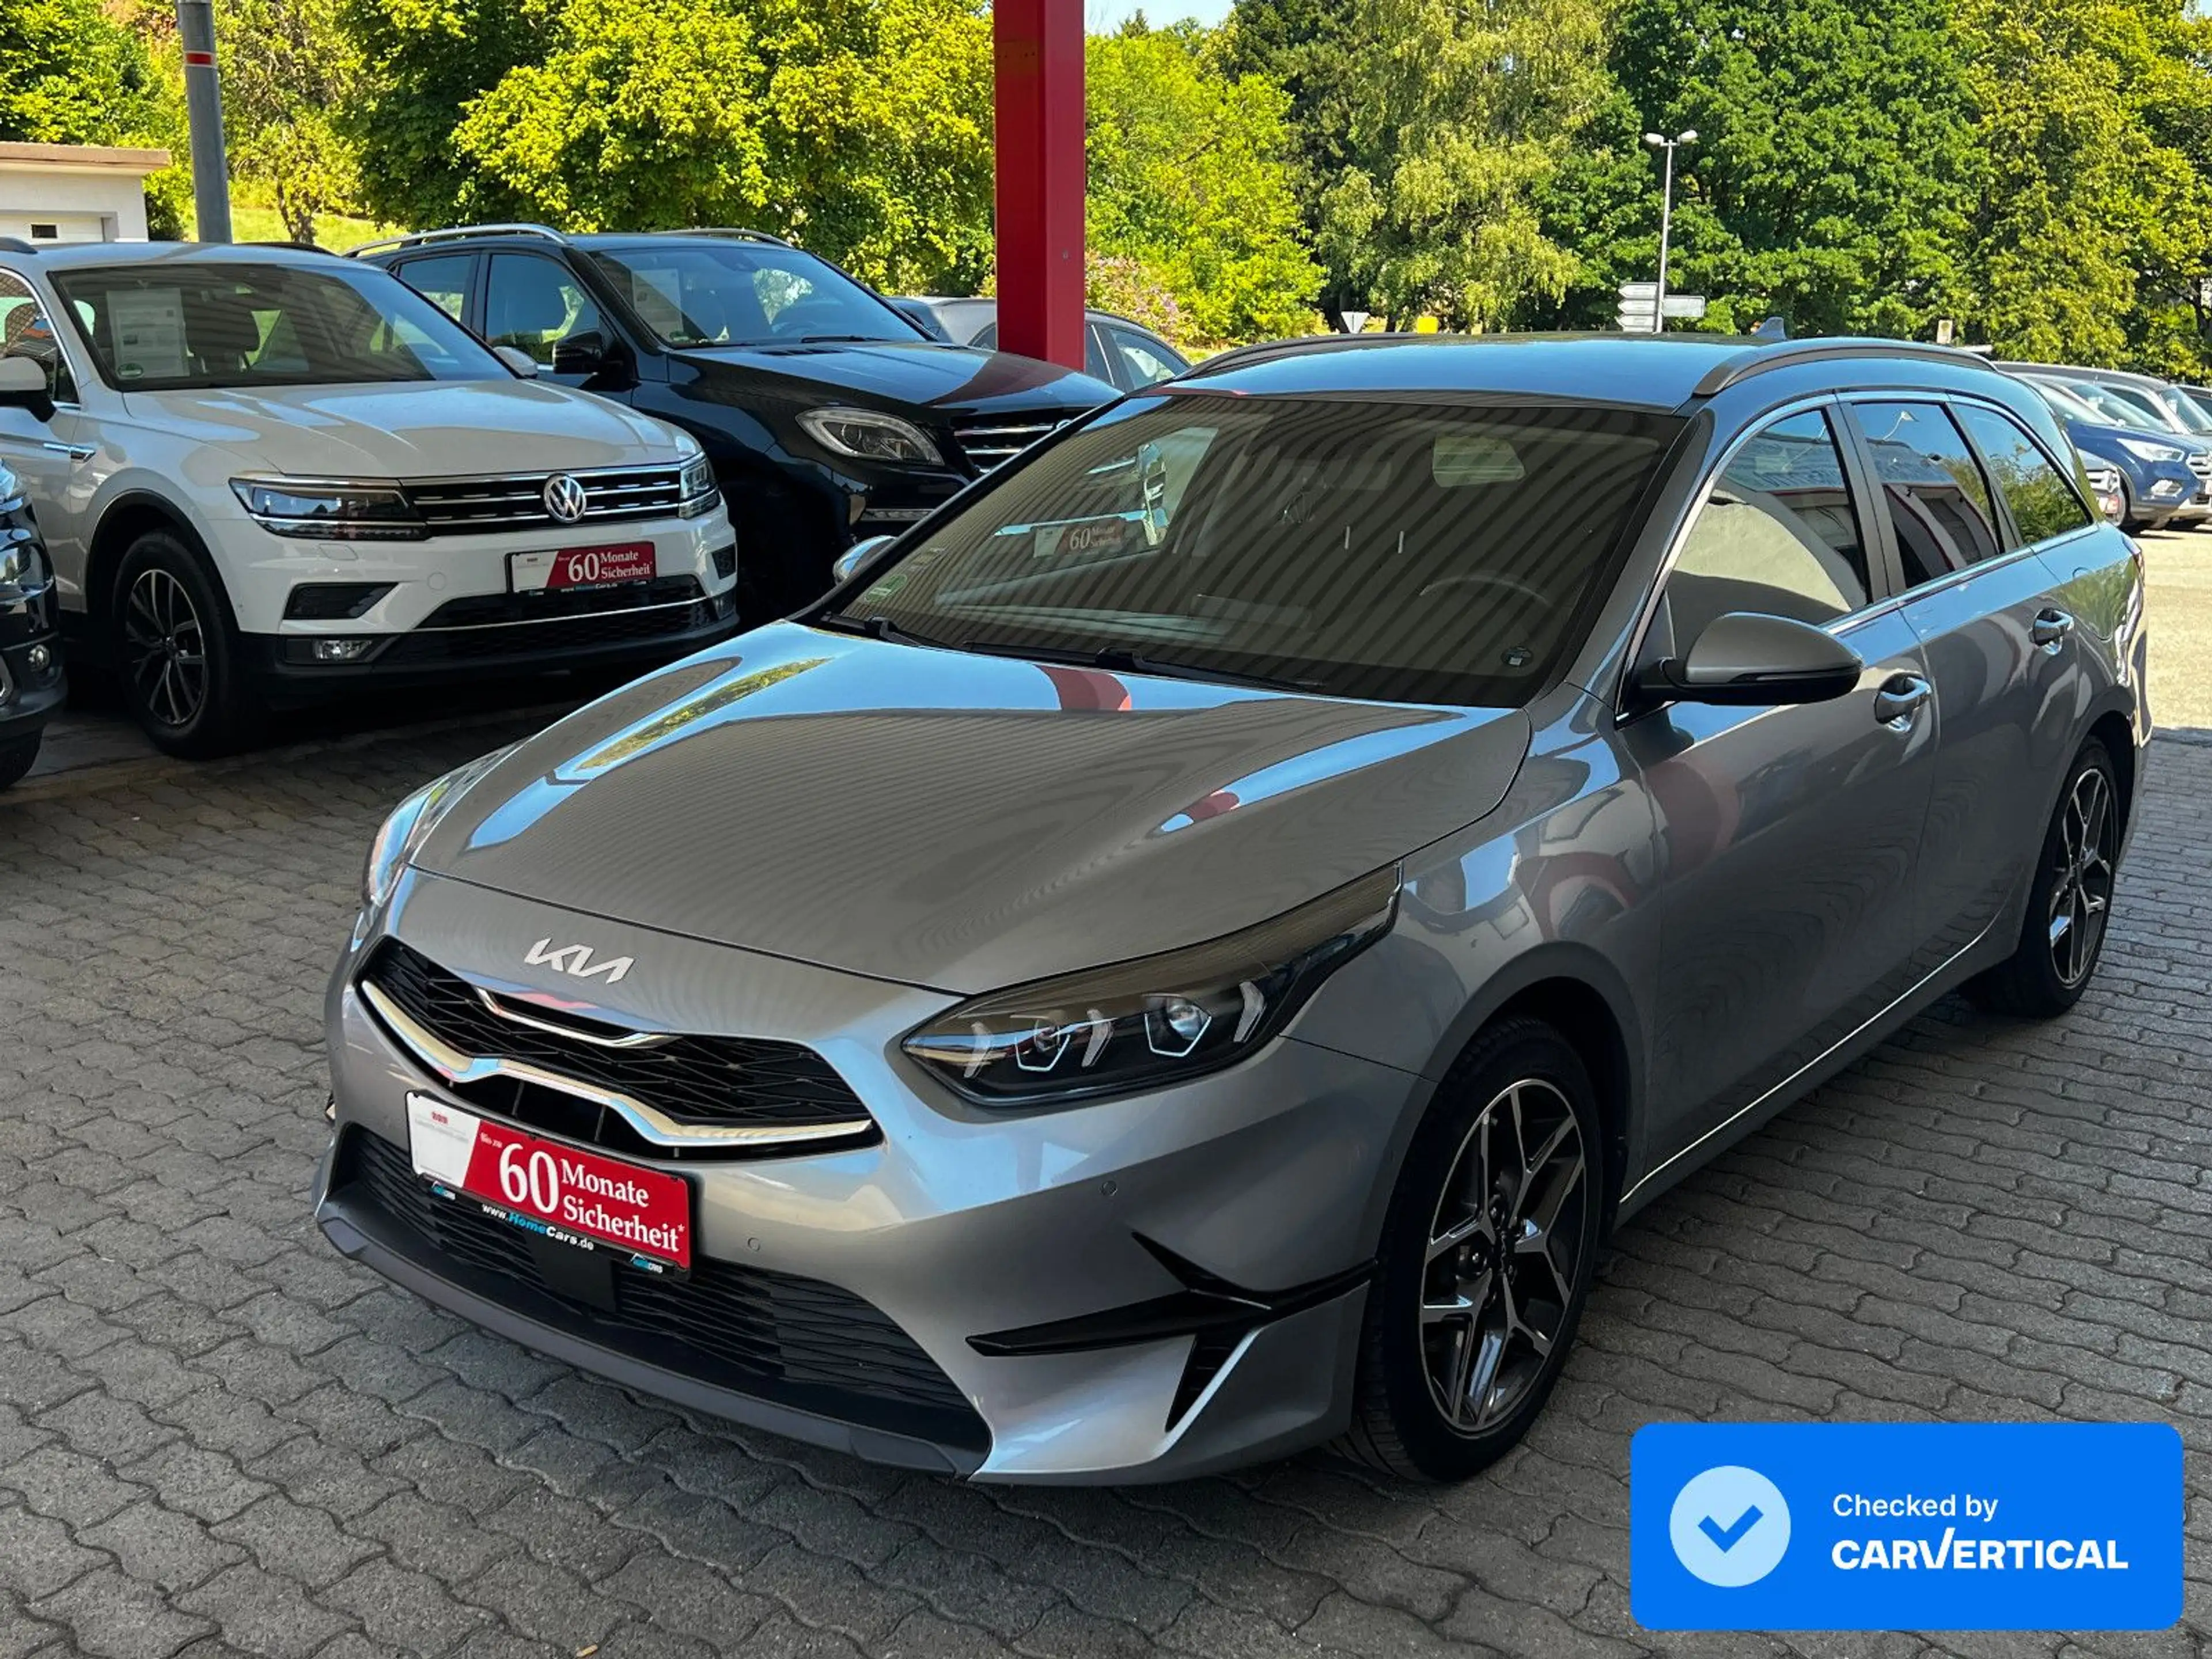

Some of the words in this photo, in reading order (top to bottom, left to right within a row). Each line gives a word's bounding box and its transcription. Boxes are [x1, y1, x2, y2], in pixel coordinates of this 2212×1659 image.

[568, 552, 599, 582] 60
[600, 550, 638, 563] Monate
[499, 1143, 559, 1213] 60
[560, 1158, 649, 1207] Monate
[482, 1203, 594, 1250] www.HomeCars.de
